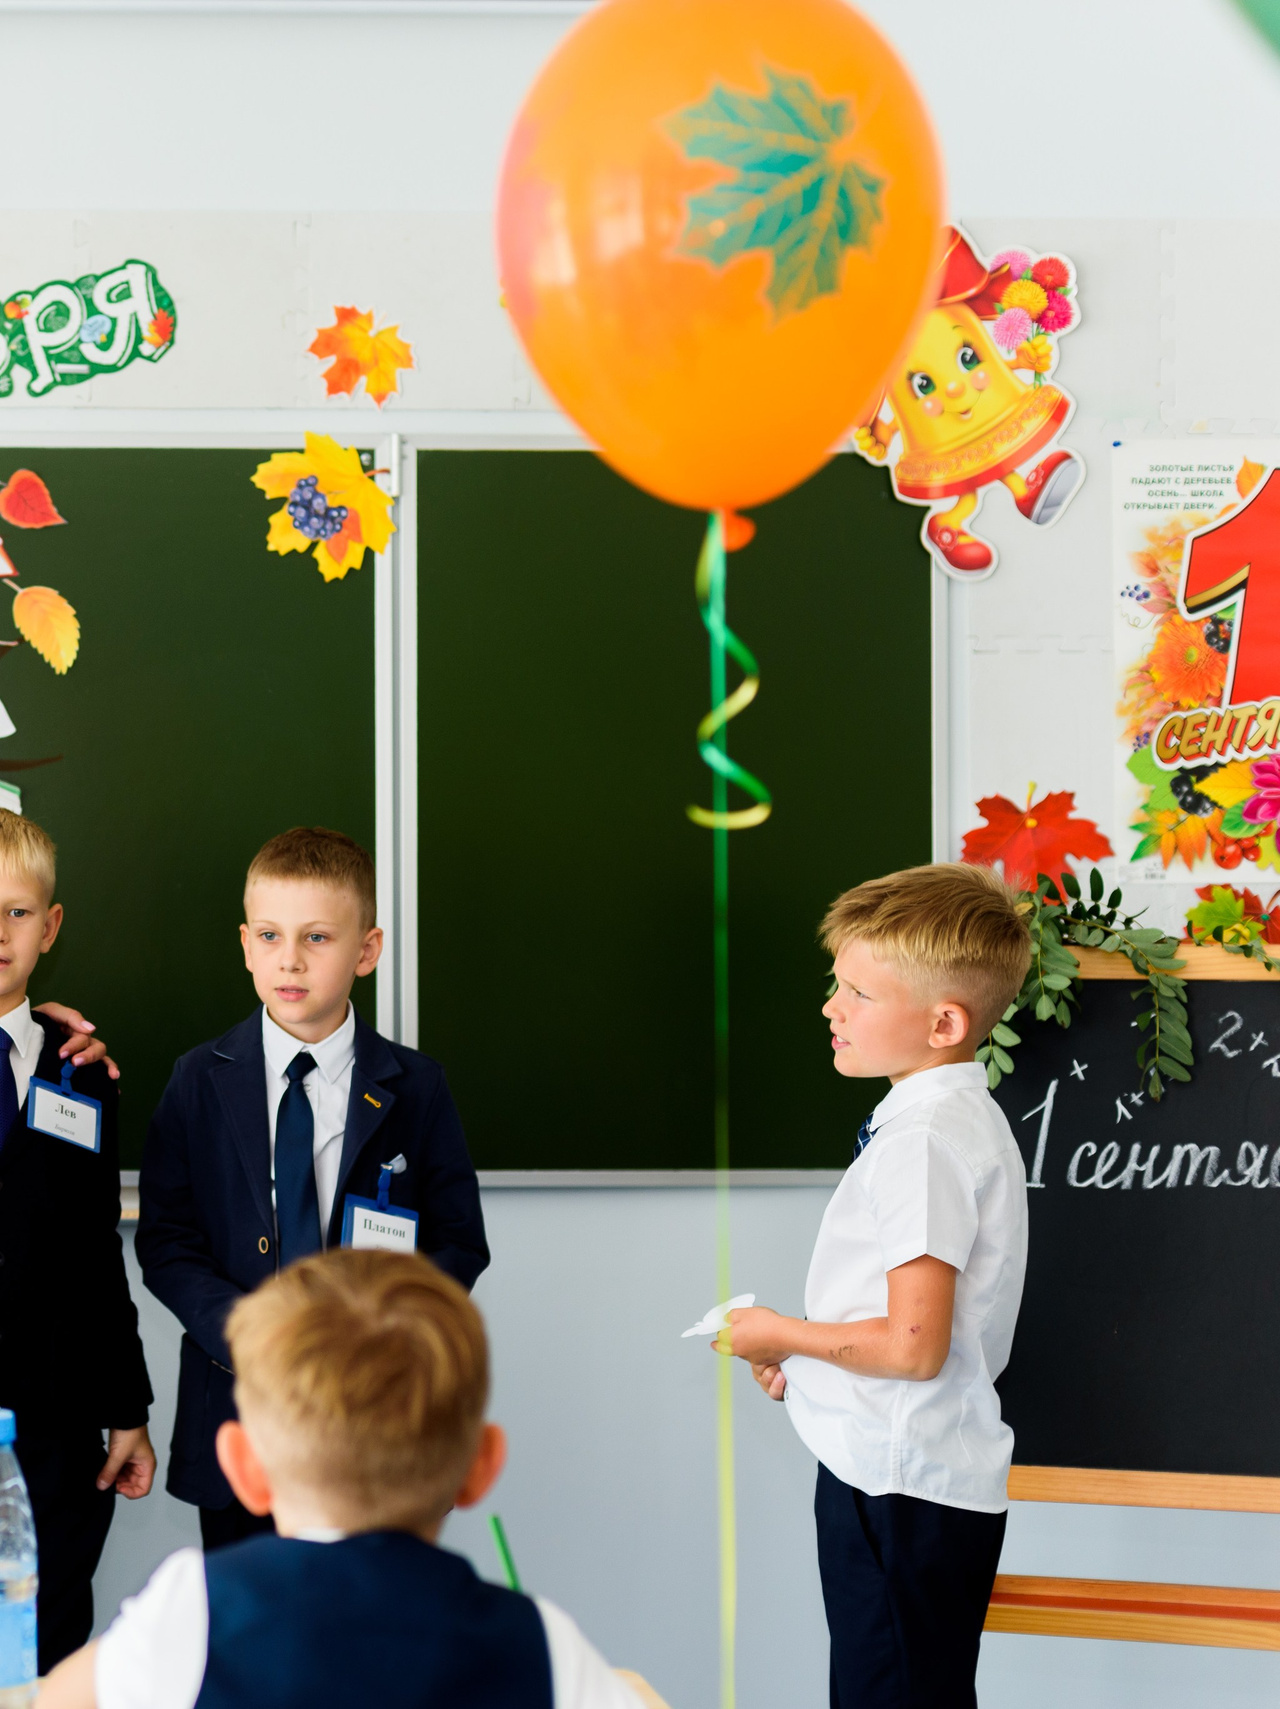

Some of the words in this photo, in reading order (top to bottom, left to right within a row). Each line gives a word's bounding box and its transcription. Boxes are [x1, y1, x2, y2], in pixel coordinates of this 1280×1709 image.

[1149, 464, 1194, 472] ЗОЛОТЫЕ
[1197, 464, 1235, 472] ЛИСТЬЯ
[1131, 477, 1171, 486] ПАДАЮТ
[1174, 477, 1181, 485] С
[1183, 477, 1235, 486] ДЕРЕВЬЕВ.
[1123, 502, 1181, 510] ОТКРЫВАЕТ
[1183, 502, 1217, 511] ДВЕРИ.
[1185, 467, 1280, 705] 1
[1156, 699, 1280, 764] СЕНТЯ
[55, 1103, 77, 1119] Лев
[1021, 1078, 1058, 1188] 1
[363, 1218, 407, 1239] Платон
